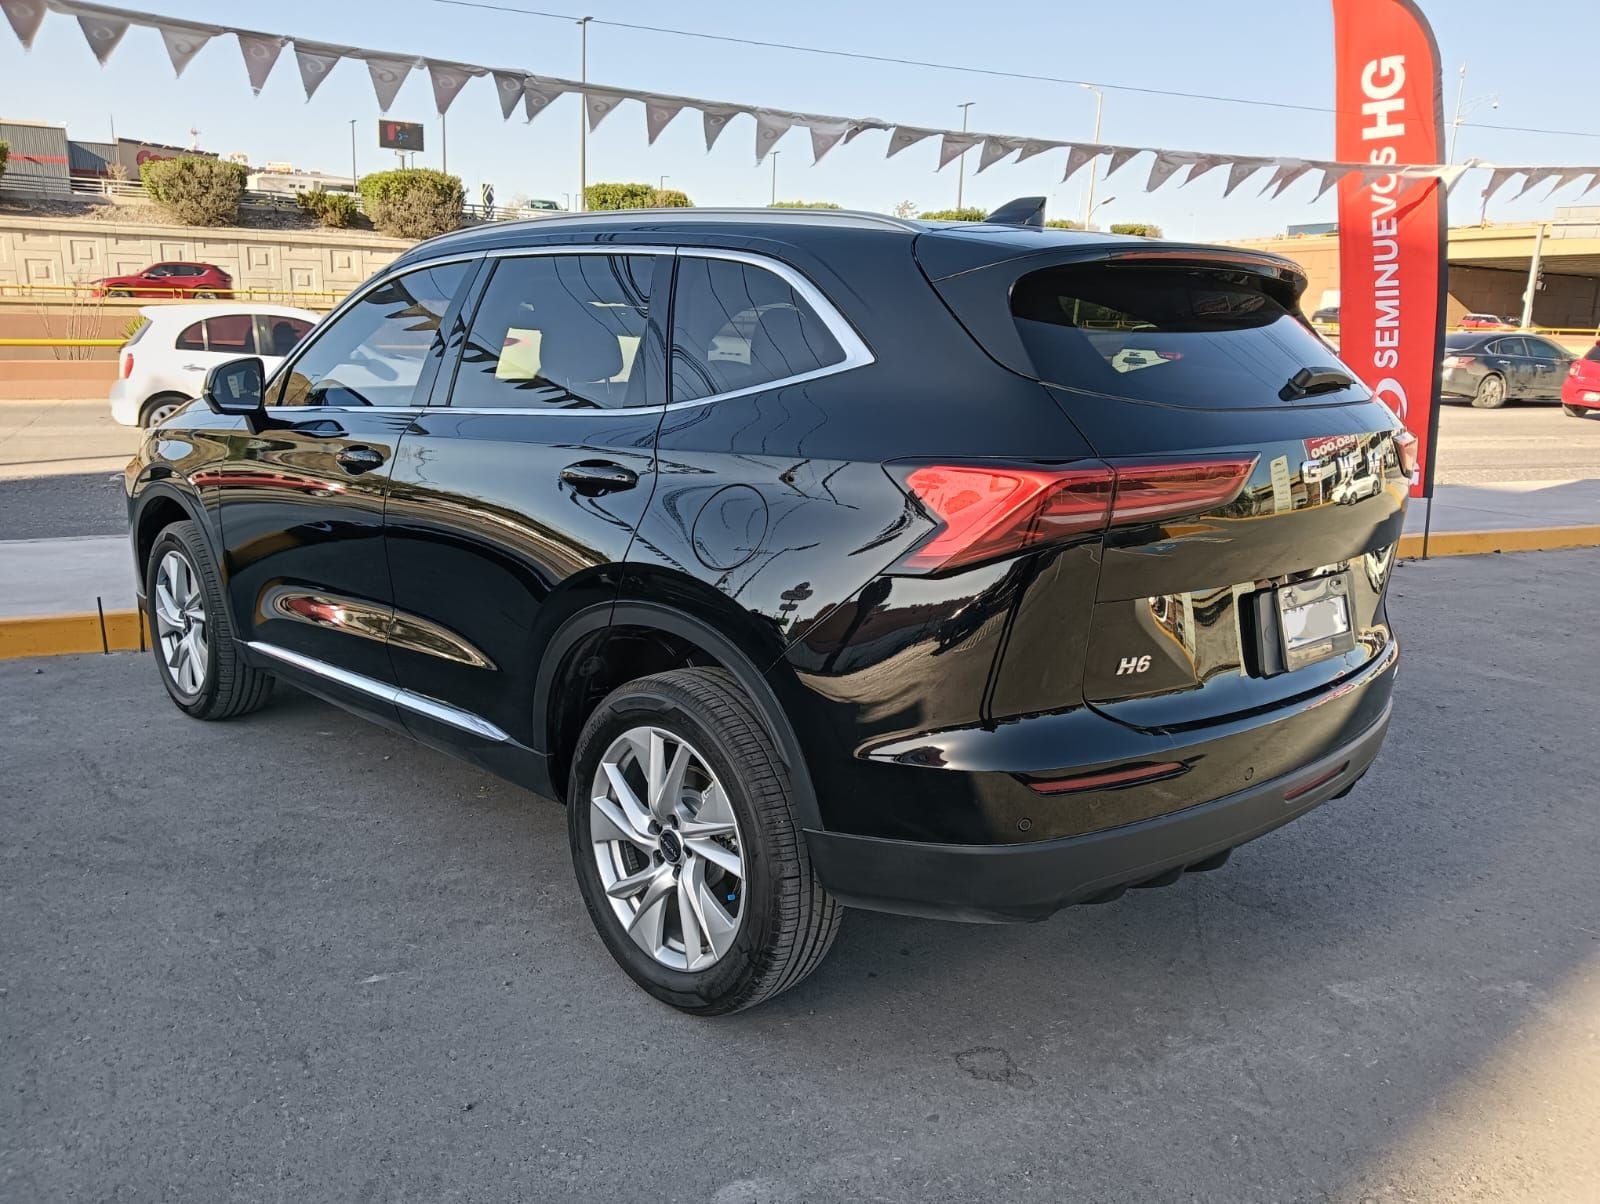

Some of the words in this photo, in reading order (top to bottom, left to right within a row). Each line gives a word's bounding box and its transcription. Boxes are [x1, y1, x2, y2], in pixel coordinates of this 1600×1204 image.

[1361, 54, 1406, 140] HG
[1371, 146, 1400, 368] SEMINUEVOS
[1116, 654, 1152, 676] H6
